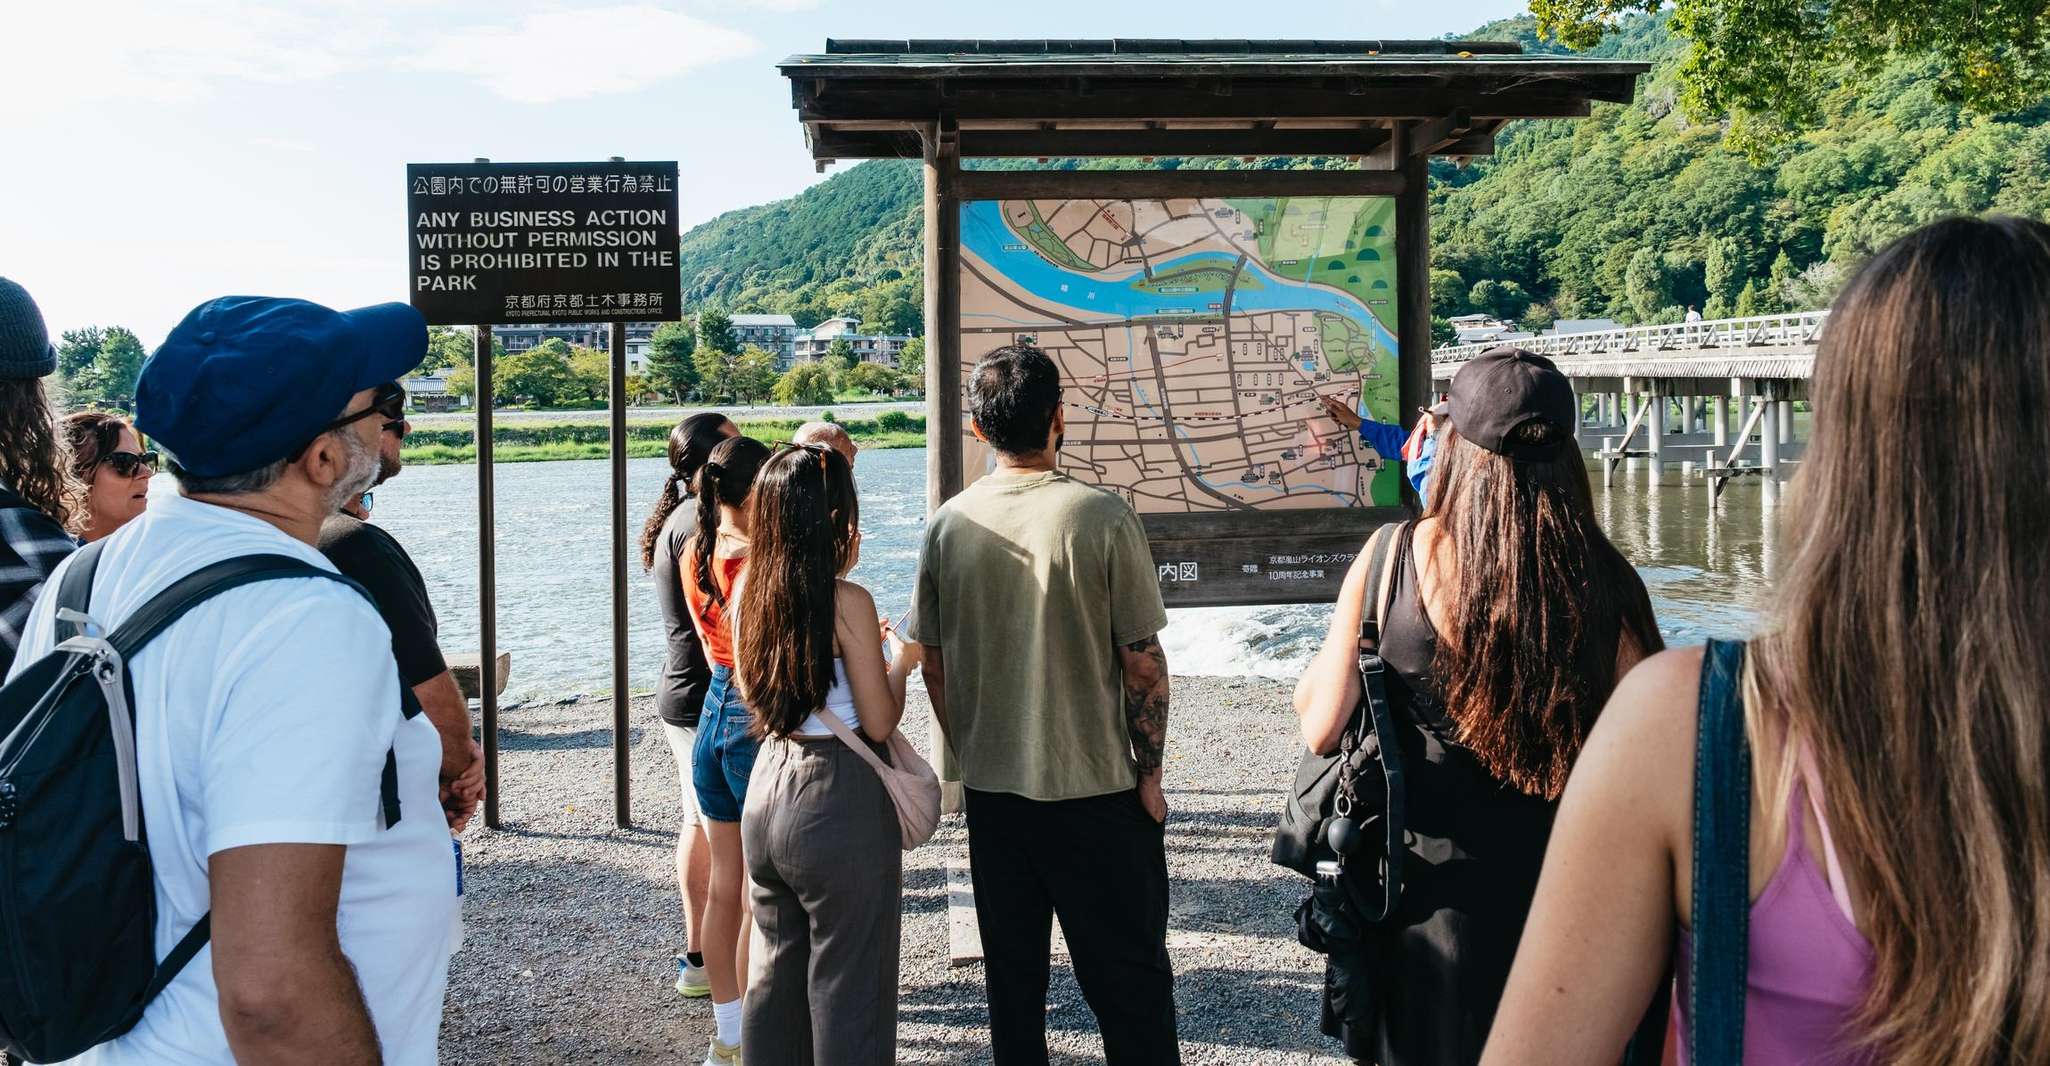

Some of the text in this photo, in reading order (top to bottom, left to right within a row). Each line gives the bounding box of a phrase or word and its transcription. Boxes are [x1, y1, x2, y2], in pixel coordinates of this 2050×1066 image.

[413, 174, 673, 196] 公園内での無許可の営業行為禁止
[416, 209, 667, 228] ANY BUSINESS ACTION
[416, 230, 657, 249] WITHOUT PERMISSION
[420, 250, 674, 270] IS PROHIBITED IN THE
[417, 275, 477, 292] PARK
[505, 292, 663, 309] 京都府京都土木事務所
[1159, 562, 1198, 582] 内図
